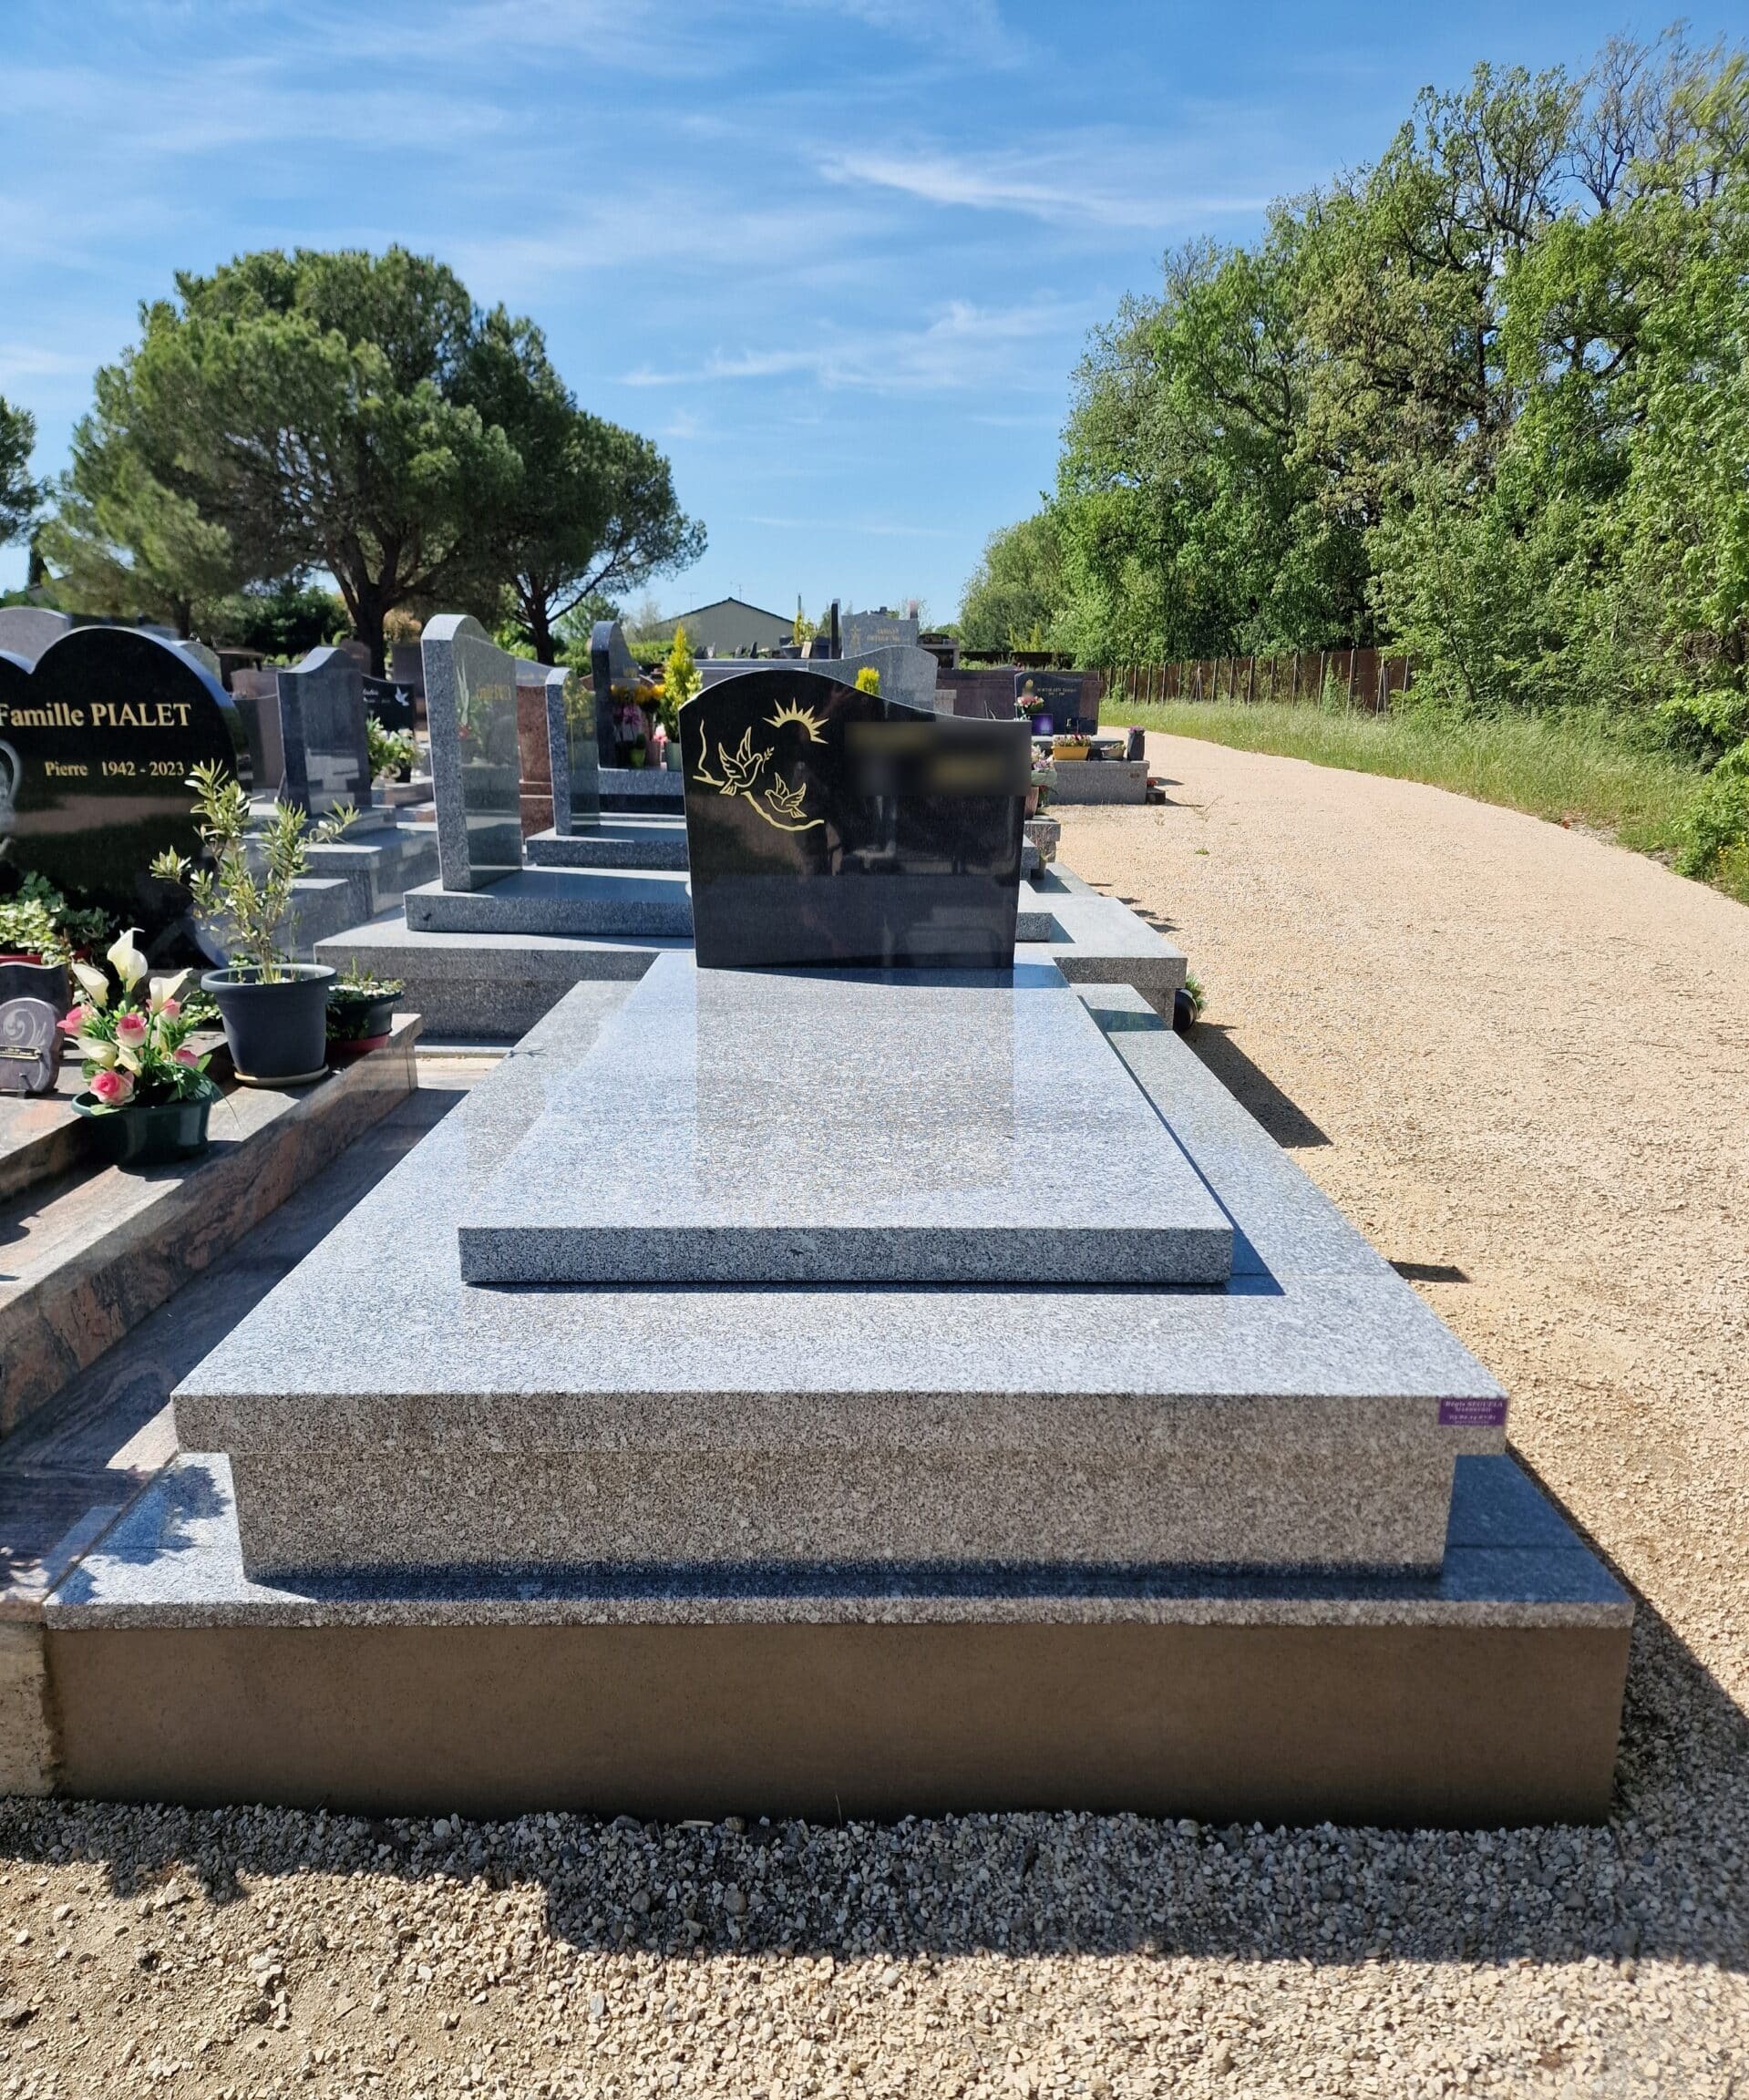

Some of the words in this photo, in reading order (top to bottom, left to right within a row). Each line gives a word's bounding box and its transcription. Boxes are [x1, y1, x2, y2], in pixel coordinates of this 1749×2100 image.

[0, 702, 85, 727] Famille
[89, 703, 191, 726] PIALET
[44, 761, 88, 777] Pierre
[102, 761, 136, 777] 1942
[150, 761, 184, 777] 2023
